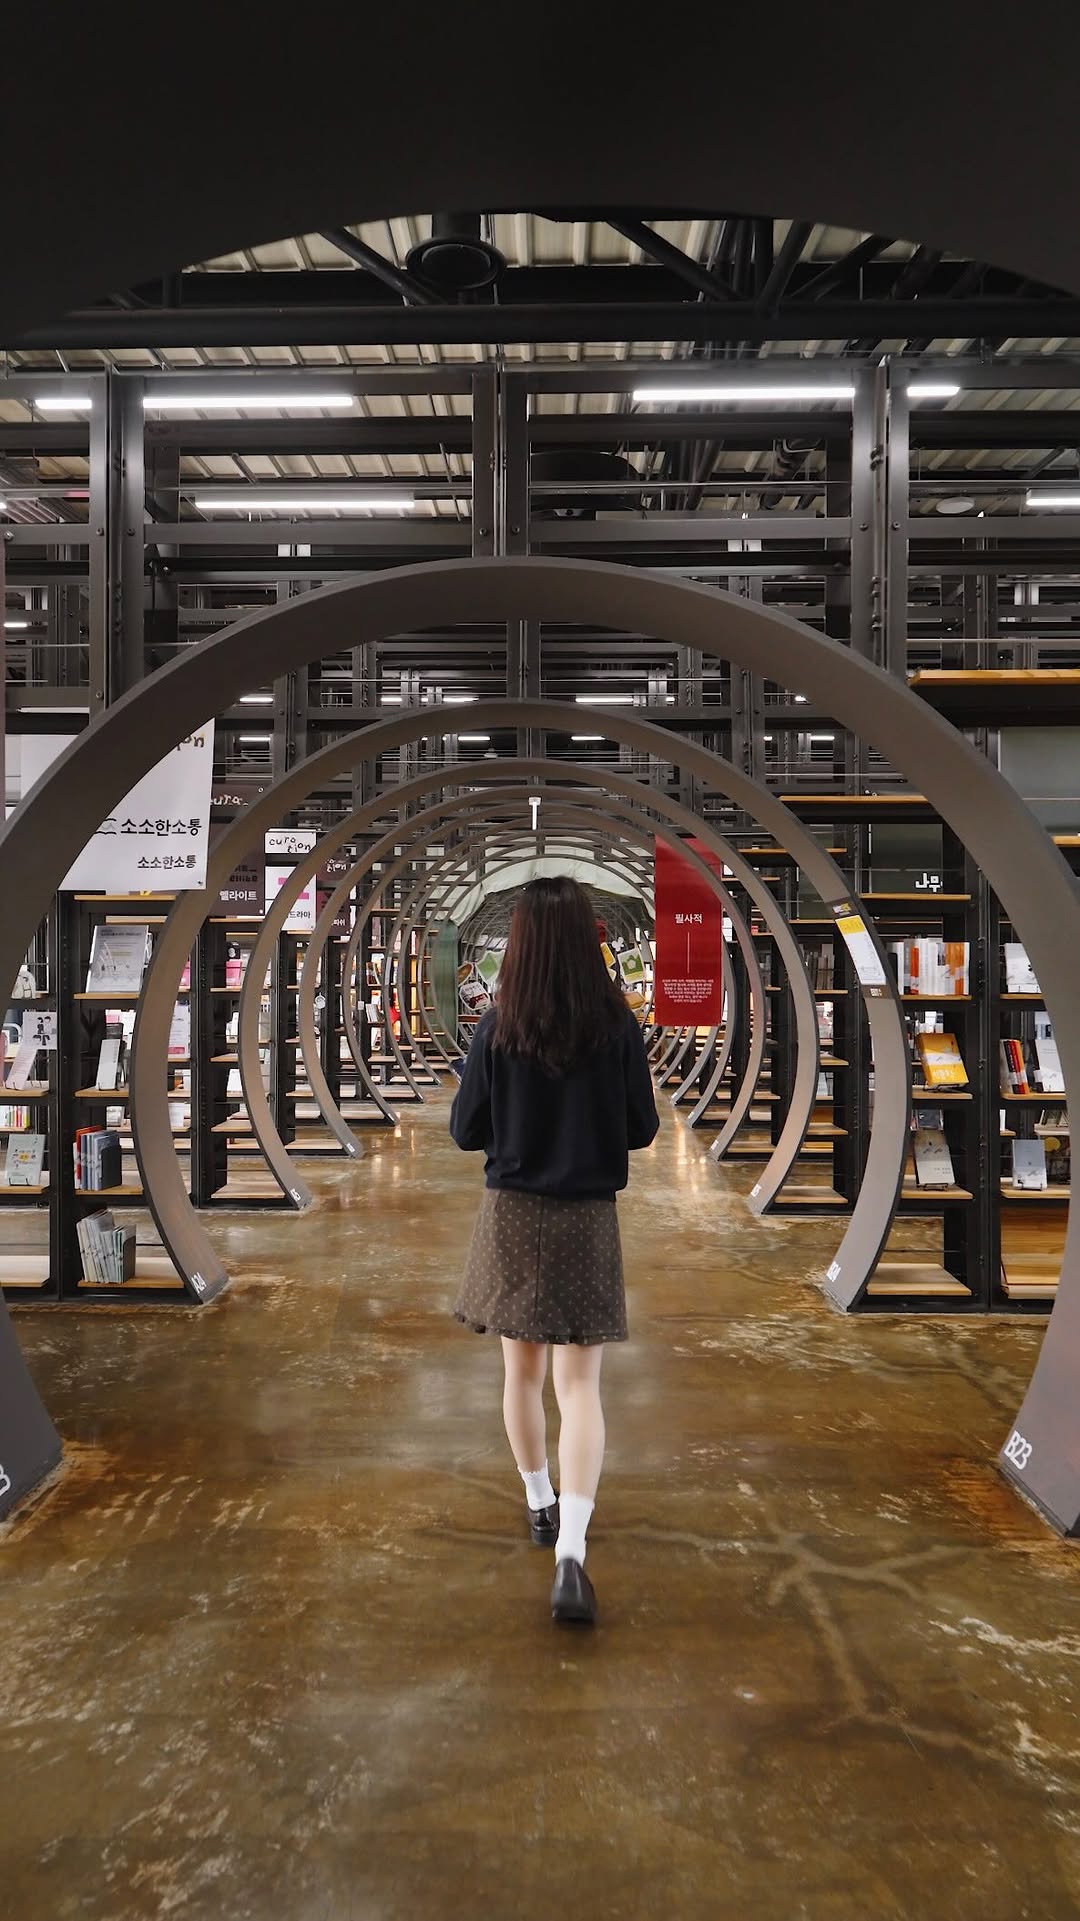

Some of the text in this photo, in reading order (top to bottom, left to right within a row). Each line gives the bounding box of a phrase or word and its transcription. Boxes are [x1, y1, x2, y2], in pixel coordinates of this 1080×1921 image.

[120, 818, 202, 836] 소소한소통
[137, 854, 197, 870] 소소한소통
[915, 872, 943, 893] 나무
[674, 913, 703, 925] 필사적
[1003, 1429, 1033, 1470] B23
